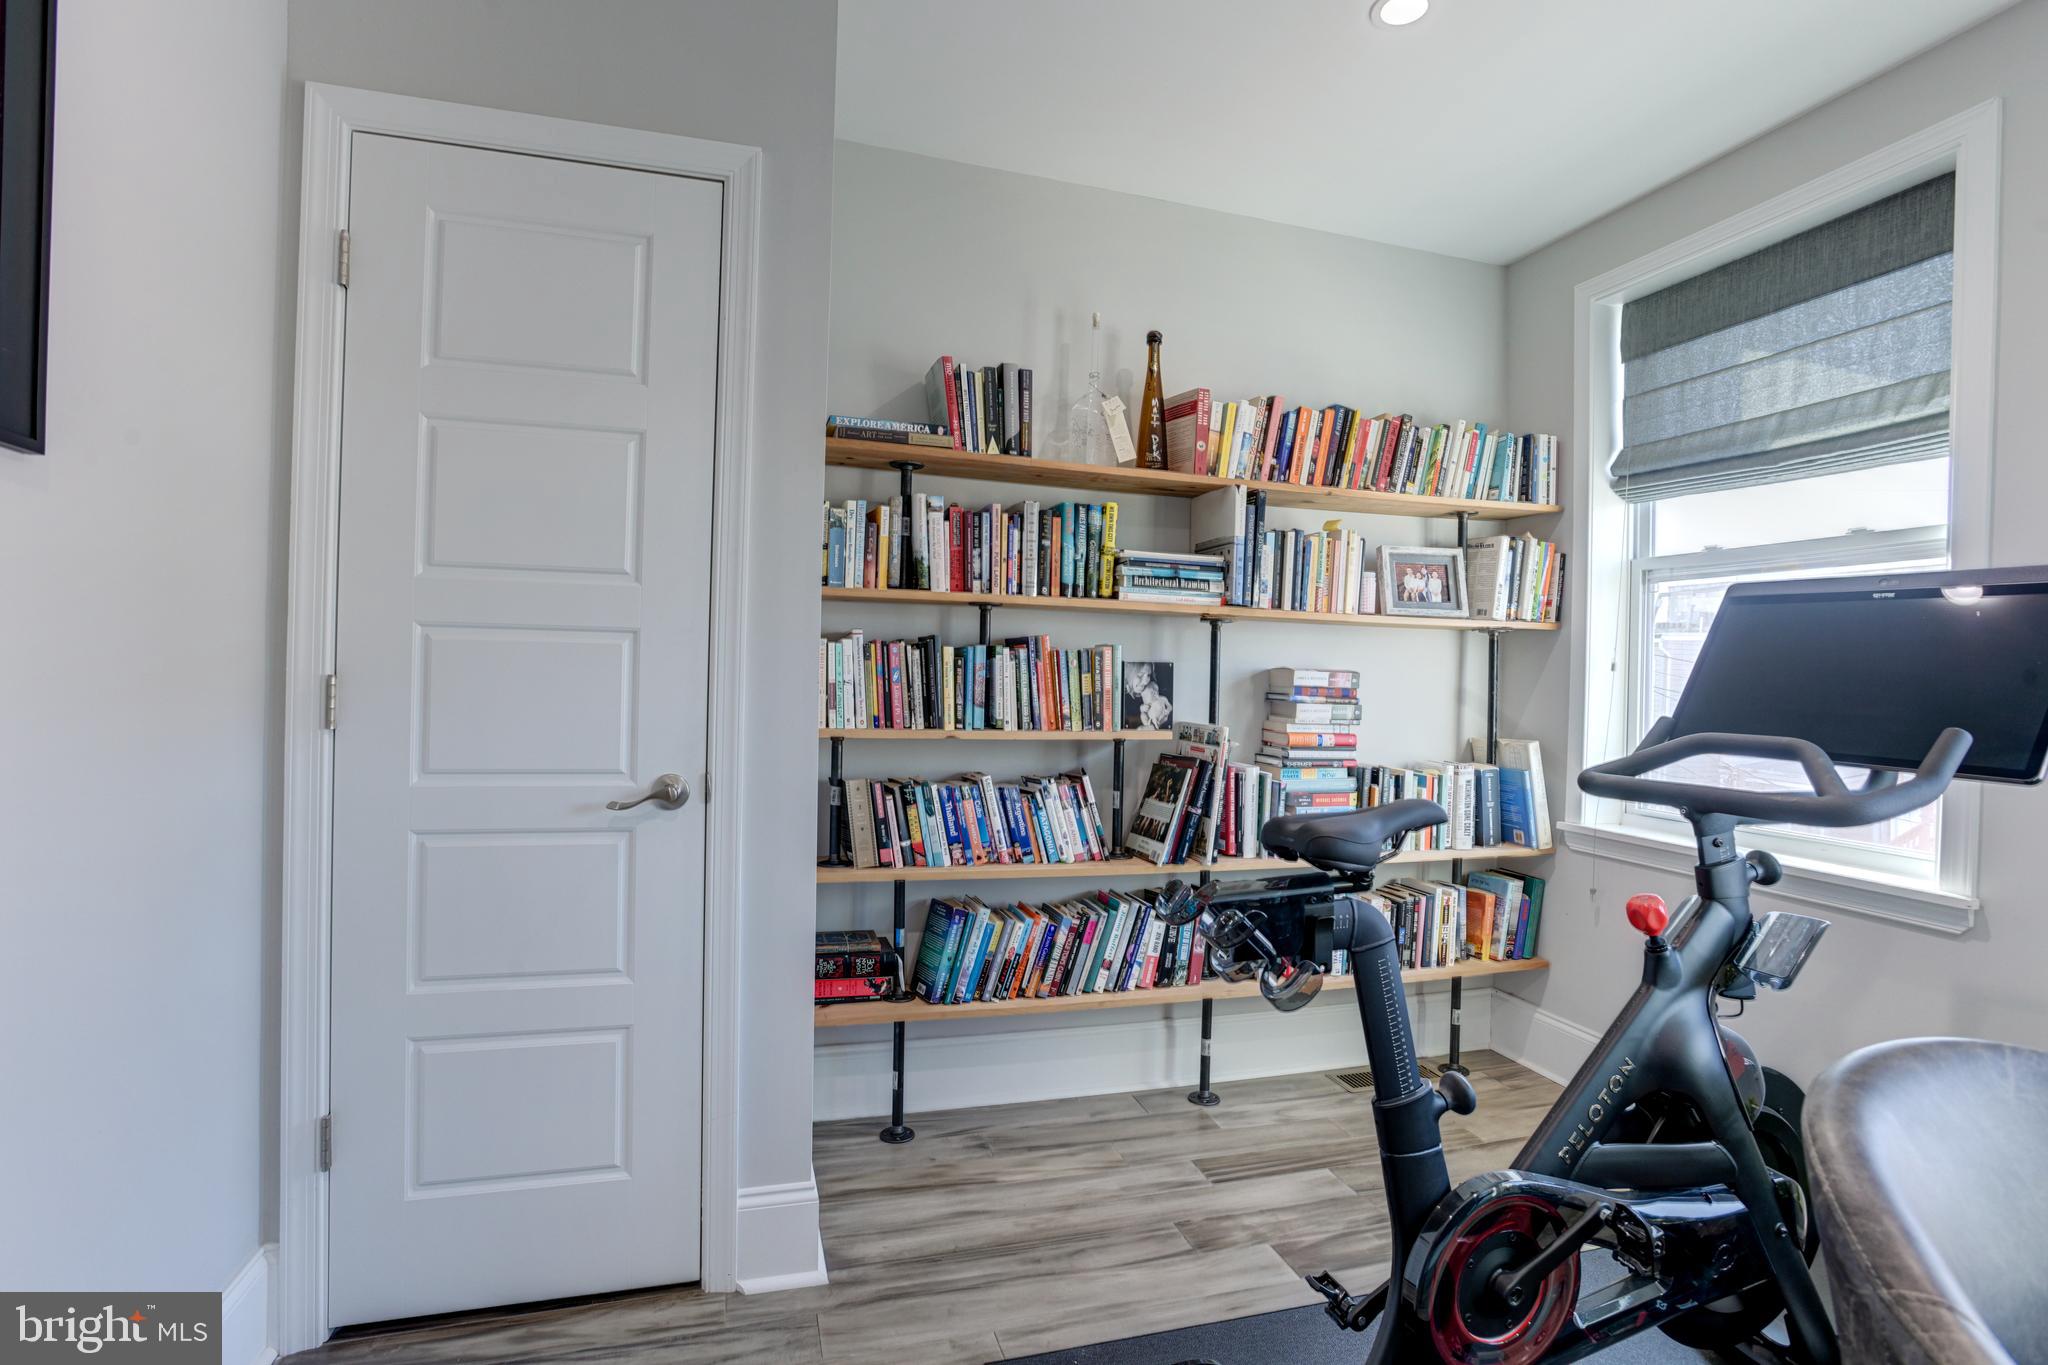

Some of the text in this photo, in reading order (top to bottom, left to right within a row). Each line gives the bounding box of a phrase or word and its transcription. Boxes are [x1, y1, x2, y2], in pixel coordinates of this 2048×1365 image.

[836, 416, 882, 430] EXPLORE
[883, 421, 931, 434] AMERICA
[1079, 506, 1087, 524] JAMES
[1134, 576, 1209, 591] Architectural Drawing
[1463, 779, 1473, 809] WASHINGTON
[945, 800, 957, 836] Thailand
[974, 800, 982, 818] Cuba
[1015, 802, 1025, 836] Argentina
[1040, 811, 1054, 855] PATAGONIA
[1463, 822, 1473, 837] CRAZY
[1064, 932, 1074, 950] UNCLE
[866, 958, 875, 973] POE
[1054, 966, 1064, 983] CABIN
[1557, 1056, 1637, 1165] PELOTON
